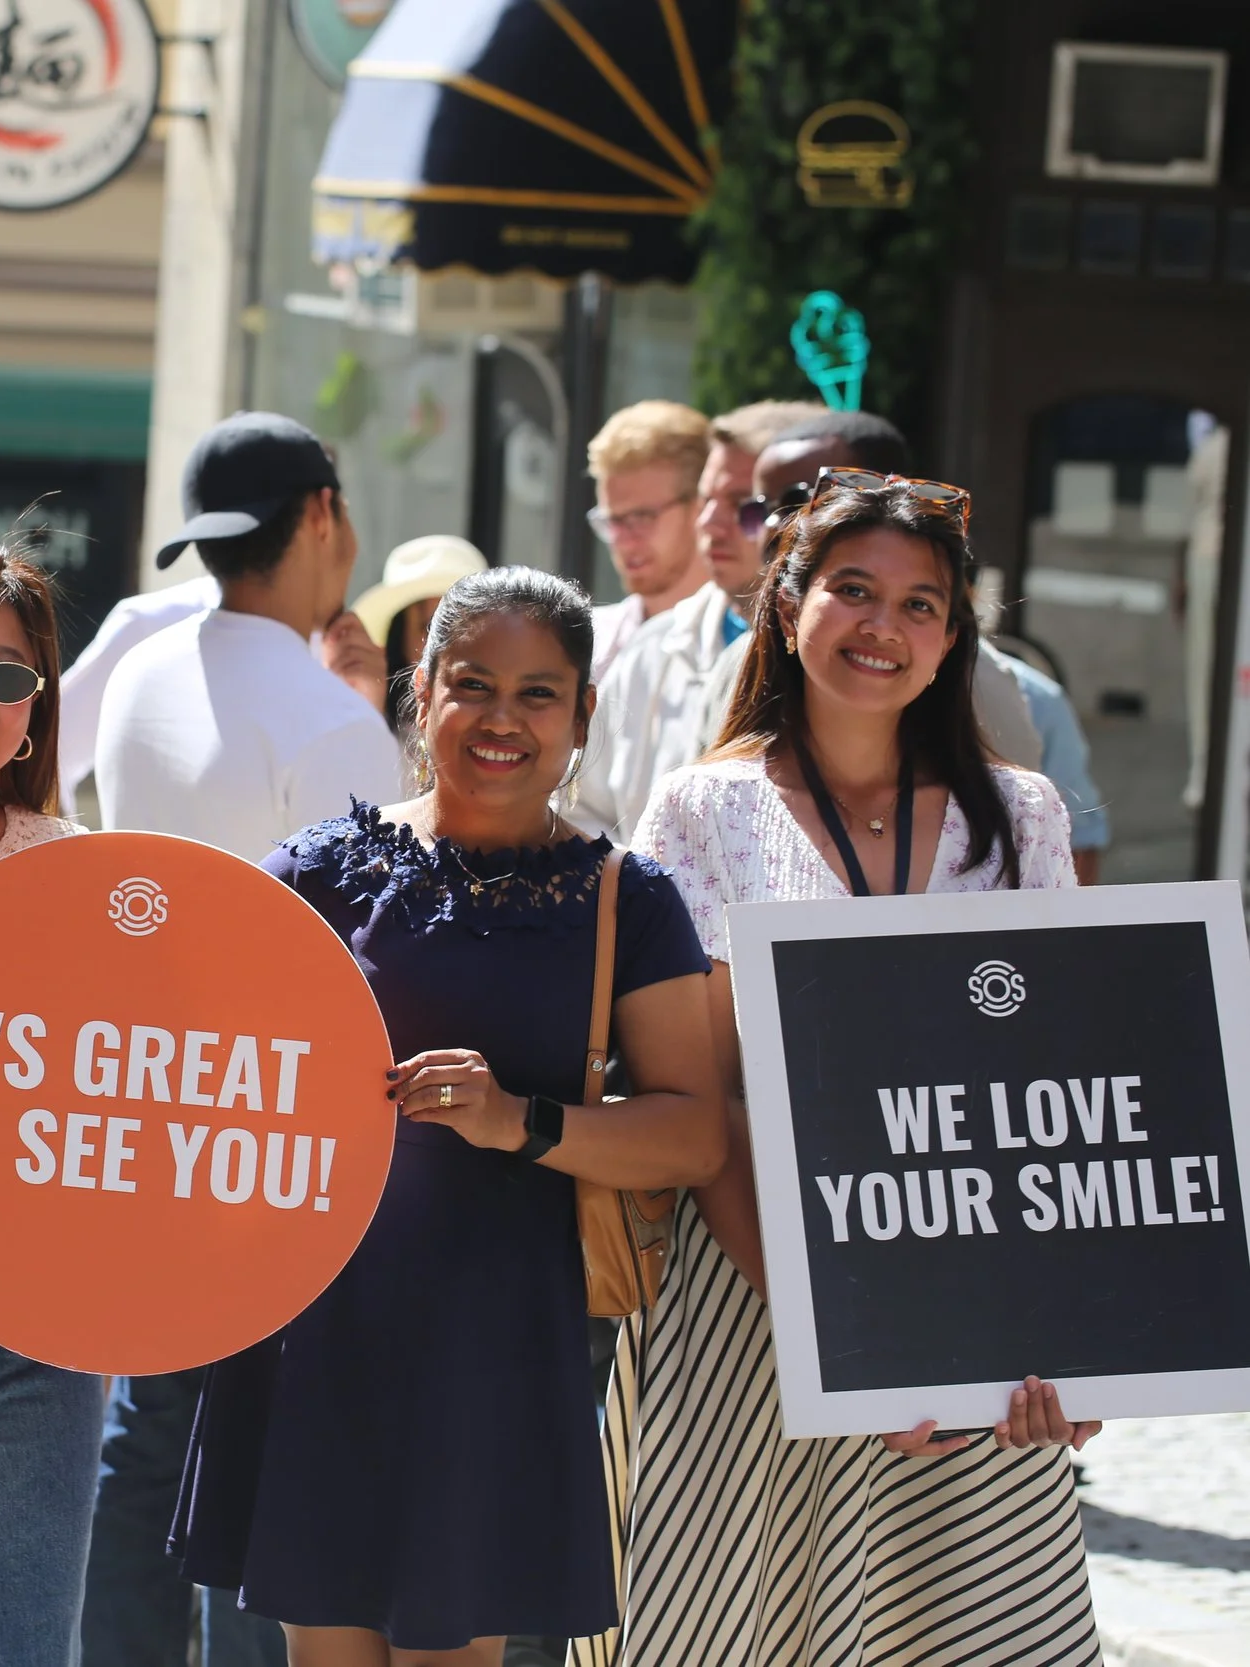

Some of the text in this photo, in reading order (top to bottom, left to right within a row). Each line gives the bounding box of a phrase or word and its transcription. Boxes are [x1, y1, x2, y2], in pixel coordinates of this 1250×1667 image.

[108, 890, 168, 924] SOS
[968, 973, 1026, 1003] SOS
[73, 1020, 311, 1114] GREAT
[878, 1076, 1148, 1154] WE LOVE
[15, 1109, 141, 1193] SEE
[167, 1122, 336, 1212] YOU!
[815, 1156, 1225, 1242] YOUR SMILE!
